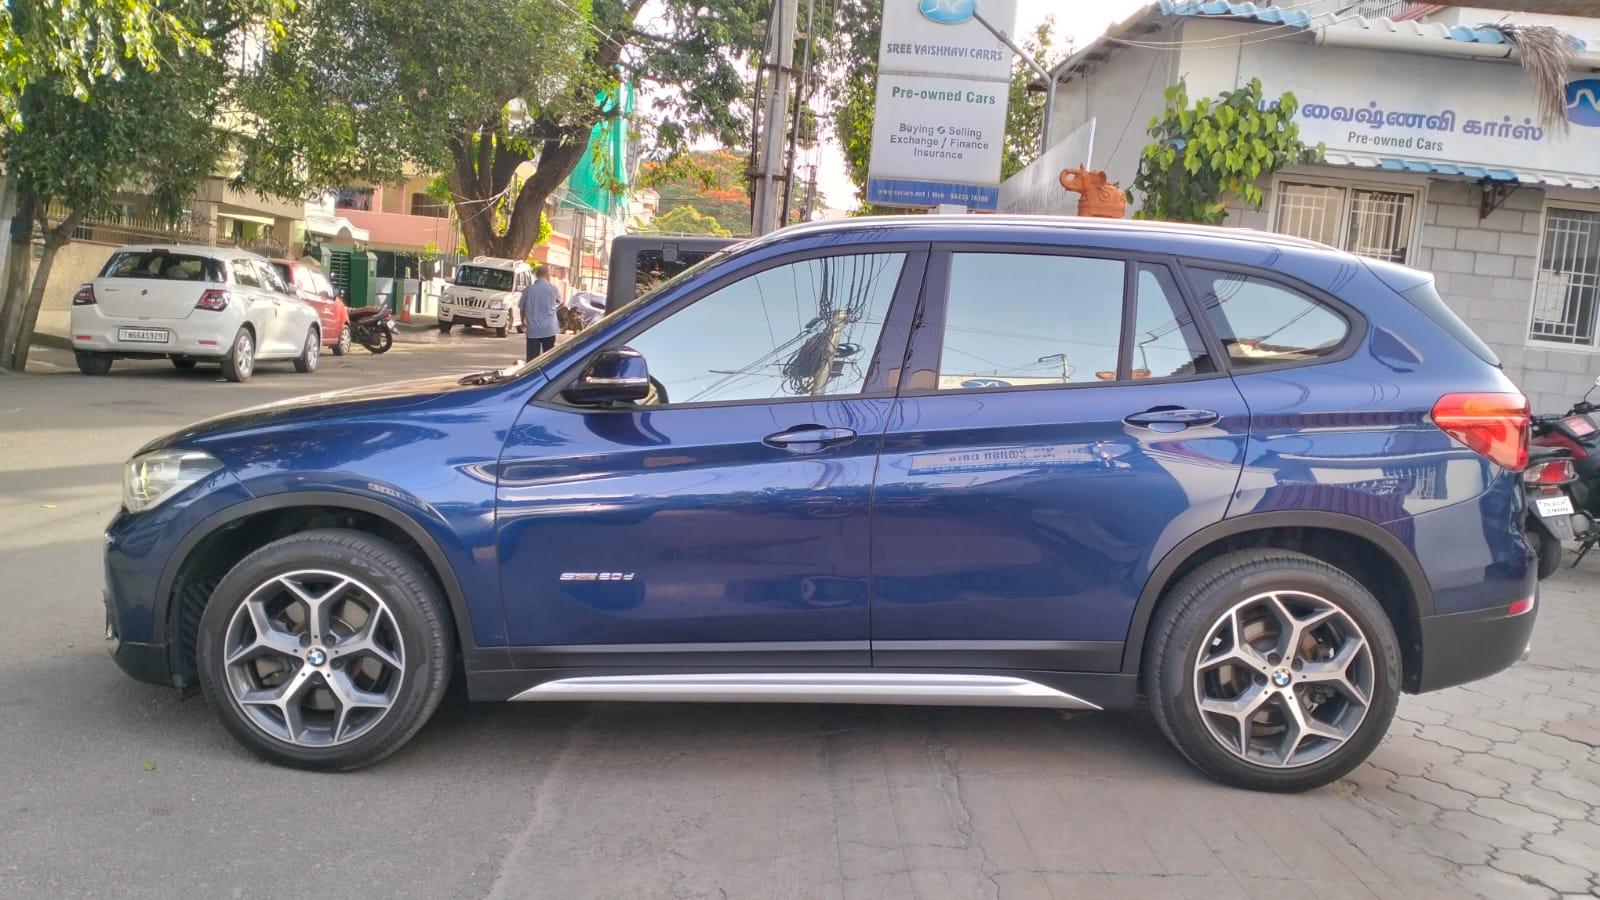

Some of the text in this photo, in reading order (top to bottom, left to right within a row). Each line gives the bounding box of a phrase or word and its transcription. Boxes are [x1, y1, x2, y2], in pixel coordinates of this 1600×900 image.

[886, 43, 1003, 61] SREE VAISHNAVI CARRS
[892, 86, 996, 105] Pre-owned Cars
[1301, 101, 1456, 132] வைஷ்ணவி
[899, 123, 982, 140] Buying Selling
[890, 134, 939, 148] Exchange
[949, 138, 989, 150] Finance
[1347, 131, 1444, 152] Pre-owned Cars
[913, 147, 964, 160] Insurance
